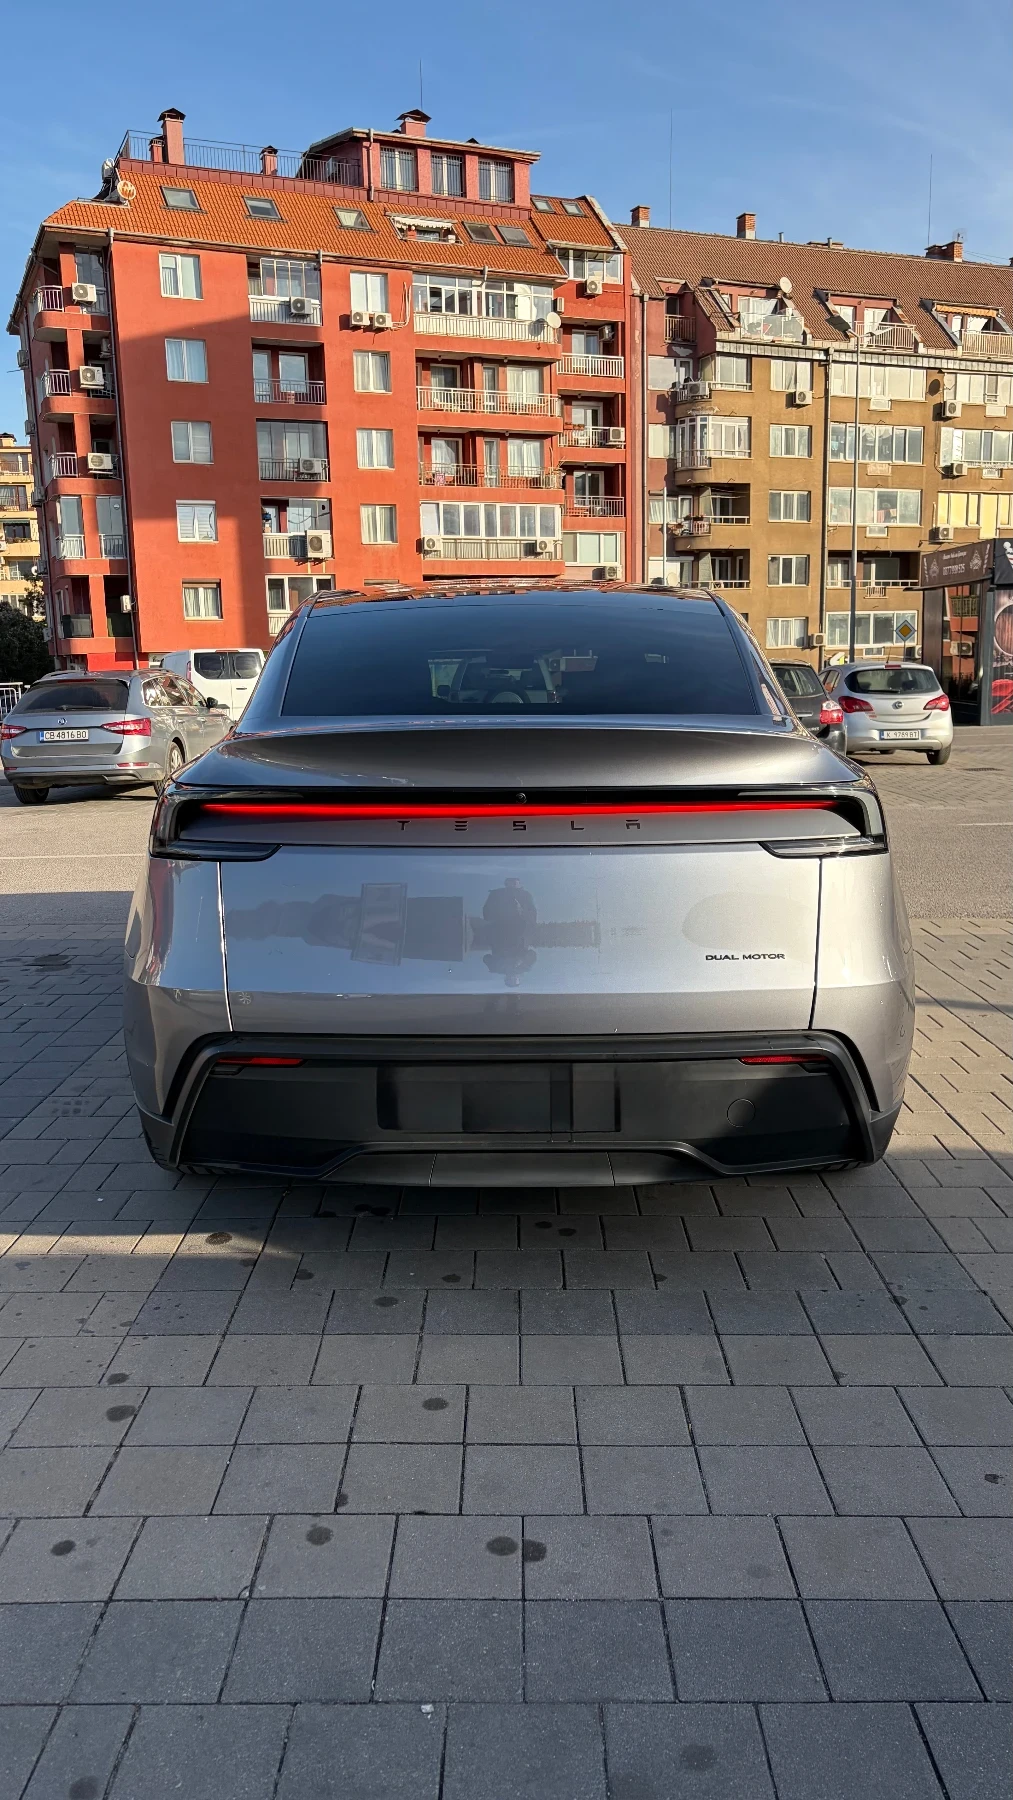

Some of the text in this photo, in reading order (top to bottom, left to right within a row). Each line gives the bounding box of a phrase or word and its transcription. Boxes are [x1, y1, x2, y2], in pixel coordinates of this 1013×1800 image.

[44, 730, 87, 739] CB 4816 BO
[396, 819, 641, 832] TESLA
